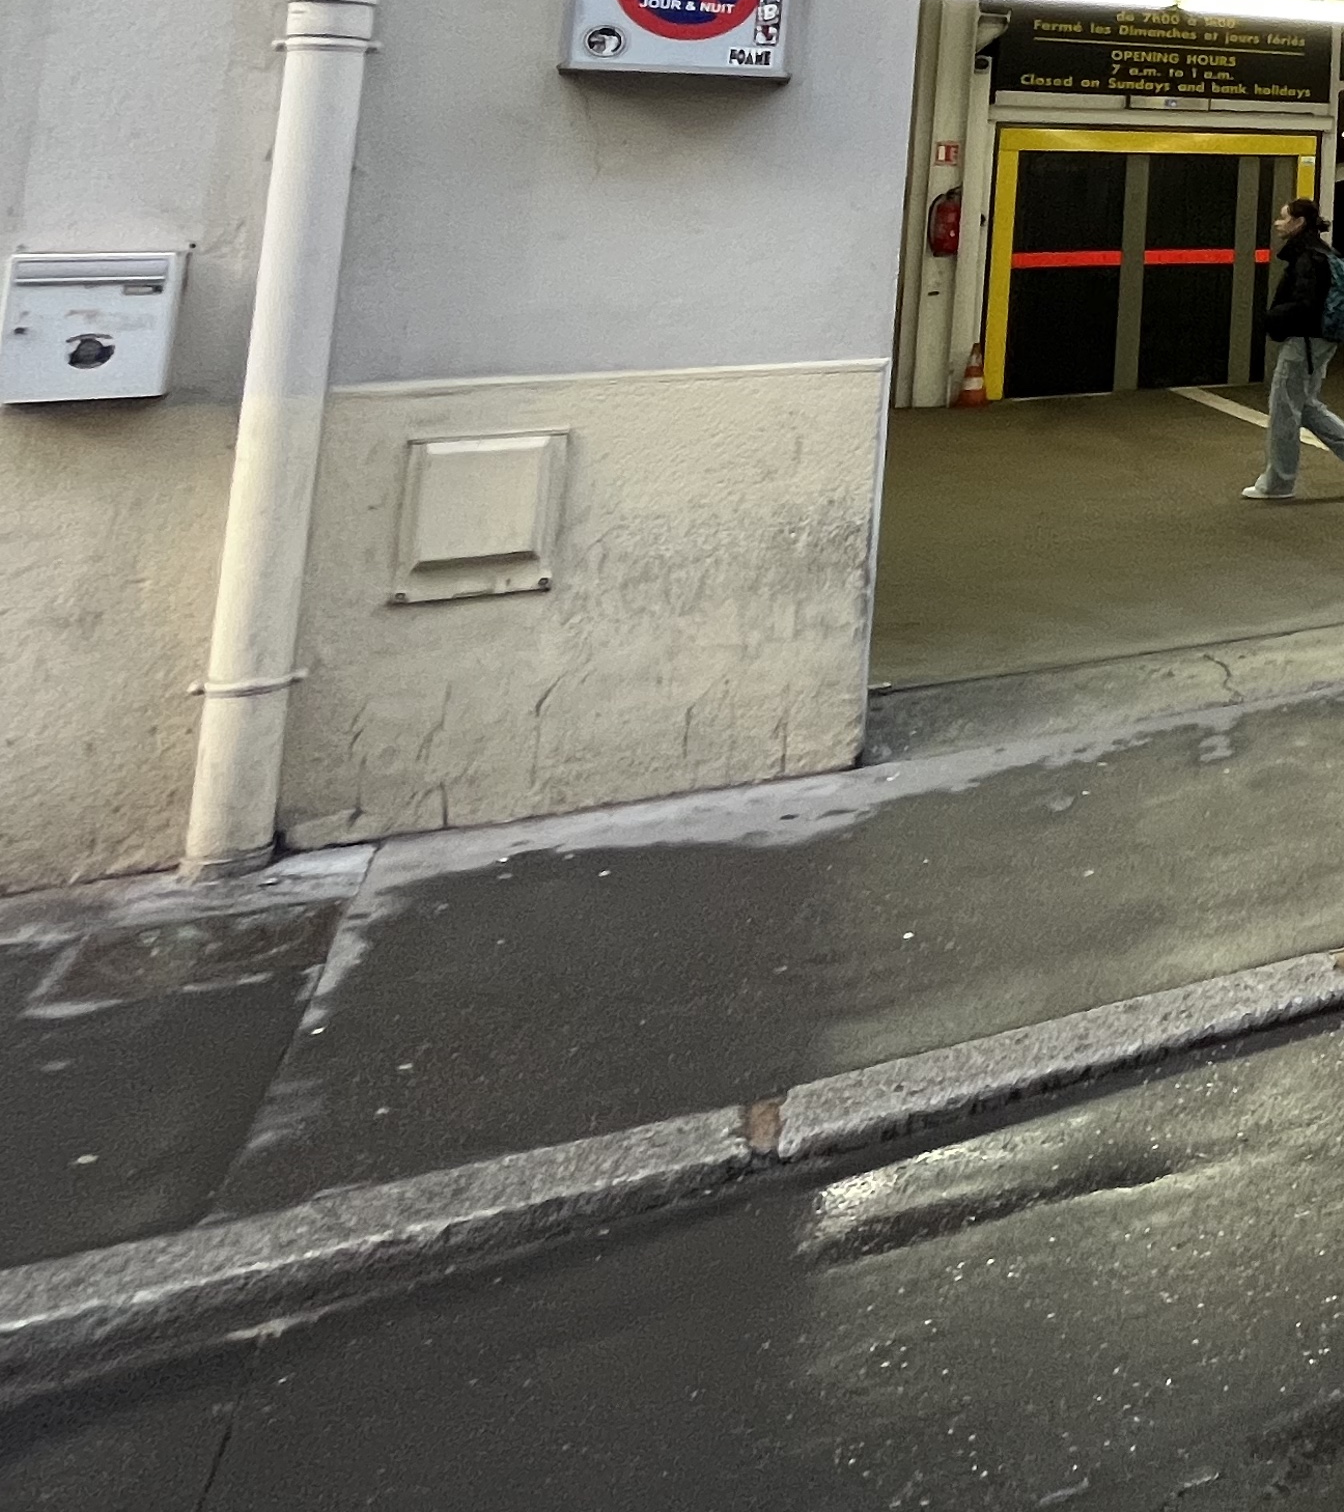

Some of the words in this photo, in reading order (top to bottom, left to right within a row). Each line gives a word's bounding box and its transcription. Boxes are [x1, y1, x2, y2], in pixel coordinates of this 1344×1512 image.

[685, 0, 696, 11] &
[699, 1, 735, 14] NUIT
[1033, 19, 1083, 33] Fermé
[1091, 21, 1111, 35] les
[1119, 25, 1197, 40] Dimanches
[1225, 32, 1260, 45] jours
[1111, 50, 1180, 64] OPENING
[1186, 55, 1237, 67] HOURS
[1111, 63, 1121, 75] 7
[1169, 68, 1184, 78] to
[1020, 74, 1073, 87] Closed
[1081, 78, 1100, 88] on
[1108, 78, 1170, 93] Sundays
[1178, 81, 1205, 93] and
[1212, 82, 1246, 94] bank
[1254, 83, 1311, 99] holidays
